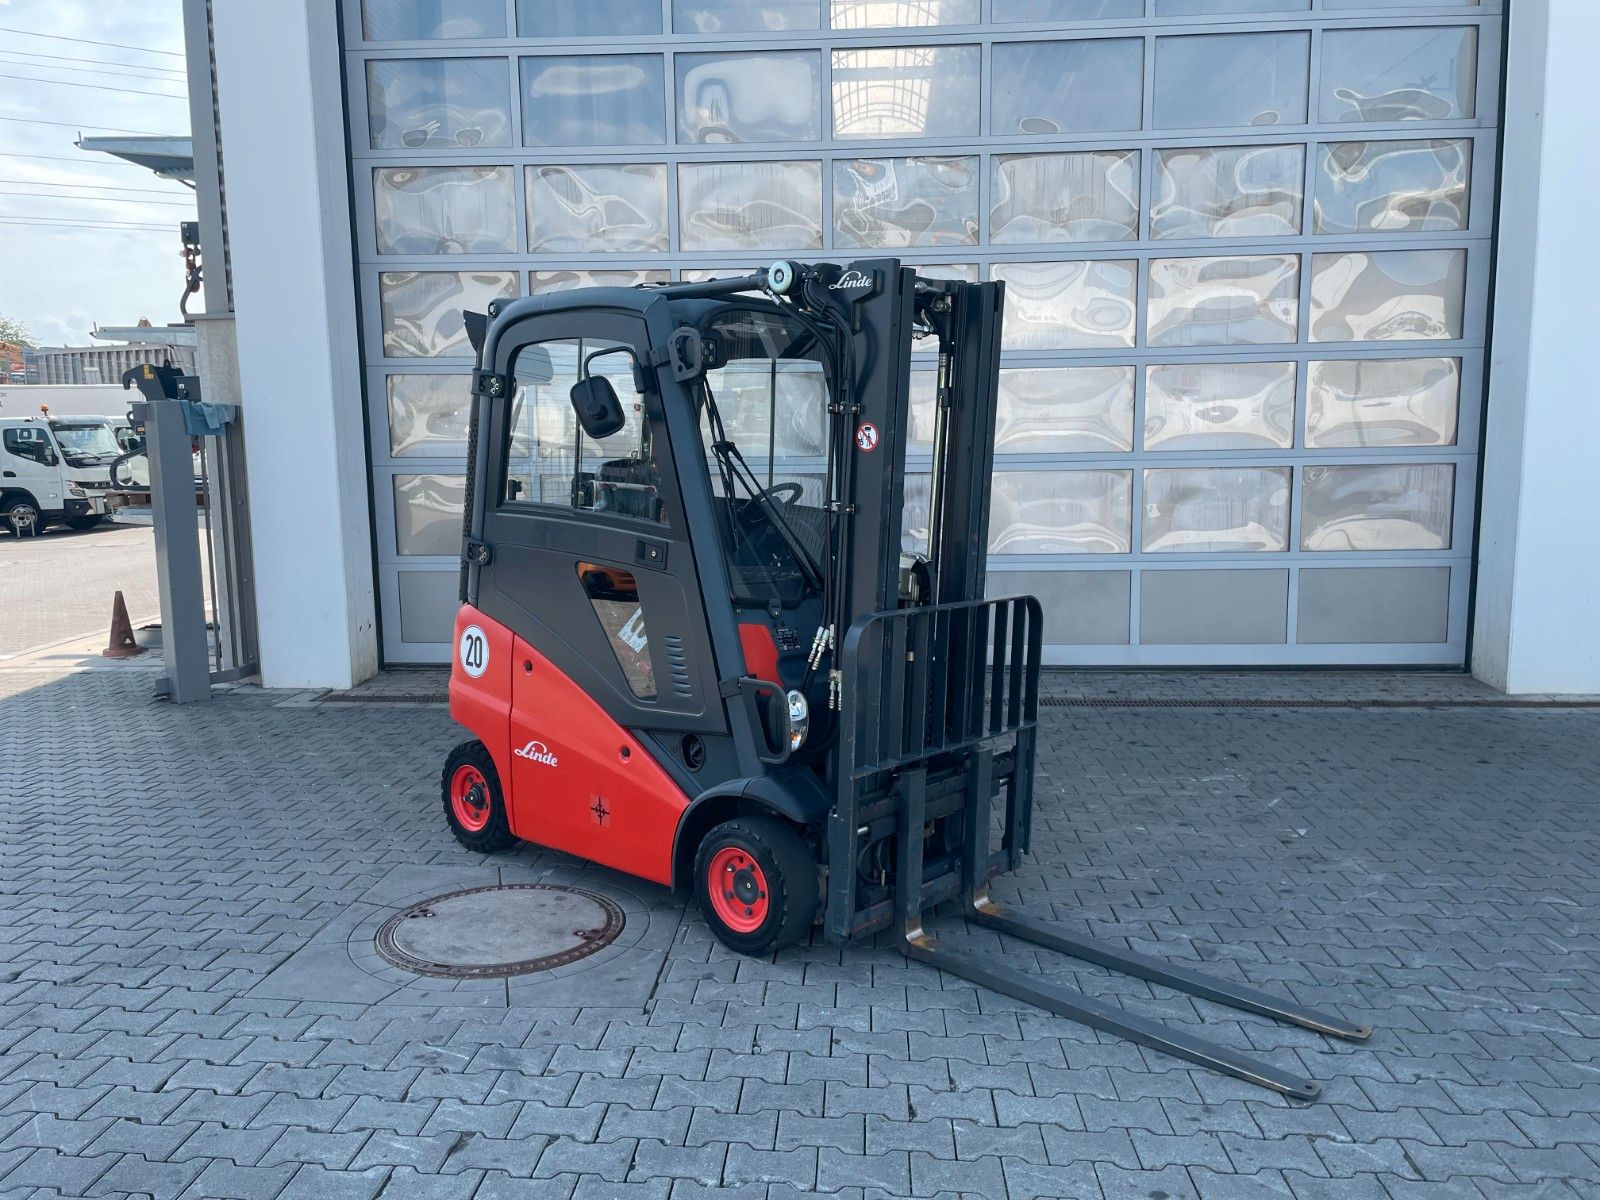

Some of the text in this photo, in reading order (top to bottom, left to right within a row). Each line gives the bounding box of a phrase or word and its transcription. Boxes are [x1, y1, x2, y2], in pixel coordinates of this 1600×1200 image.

[828, 270, 872, 290] Linde
[465, 634, 483, 668] 20
[514, 740, 558, 767] Linde
